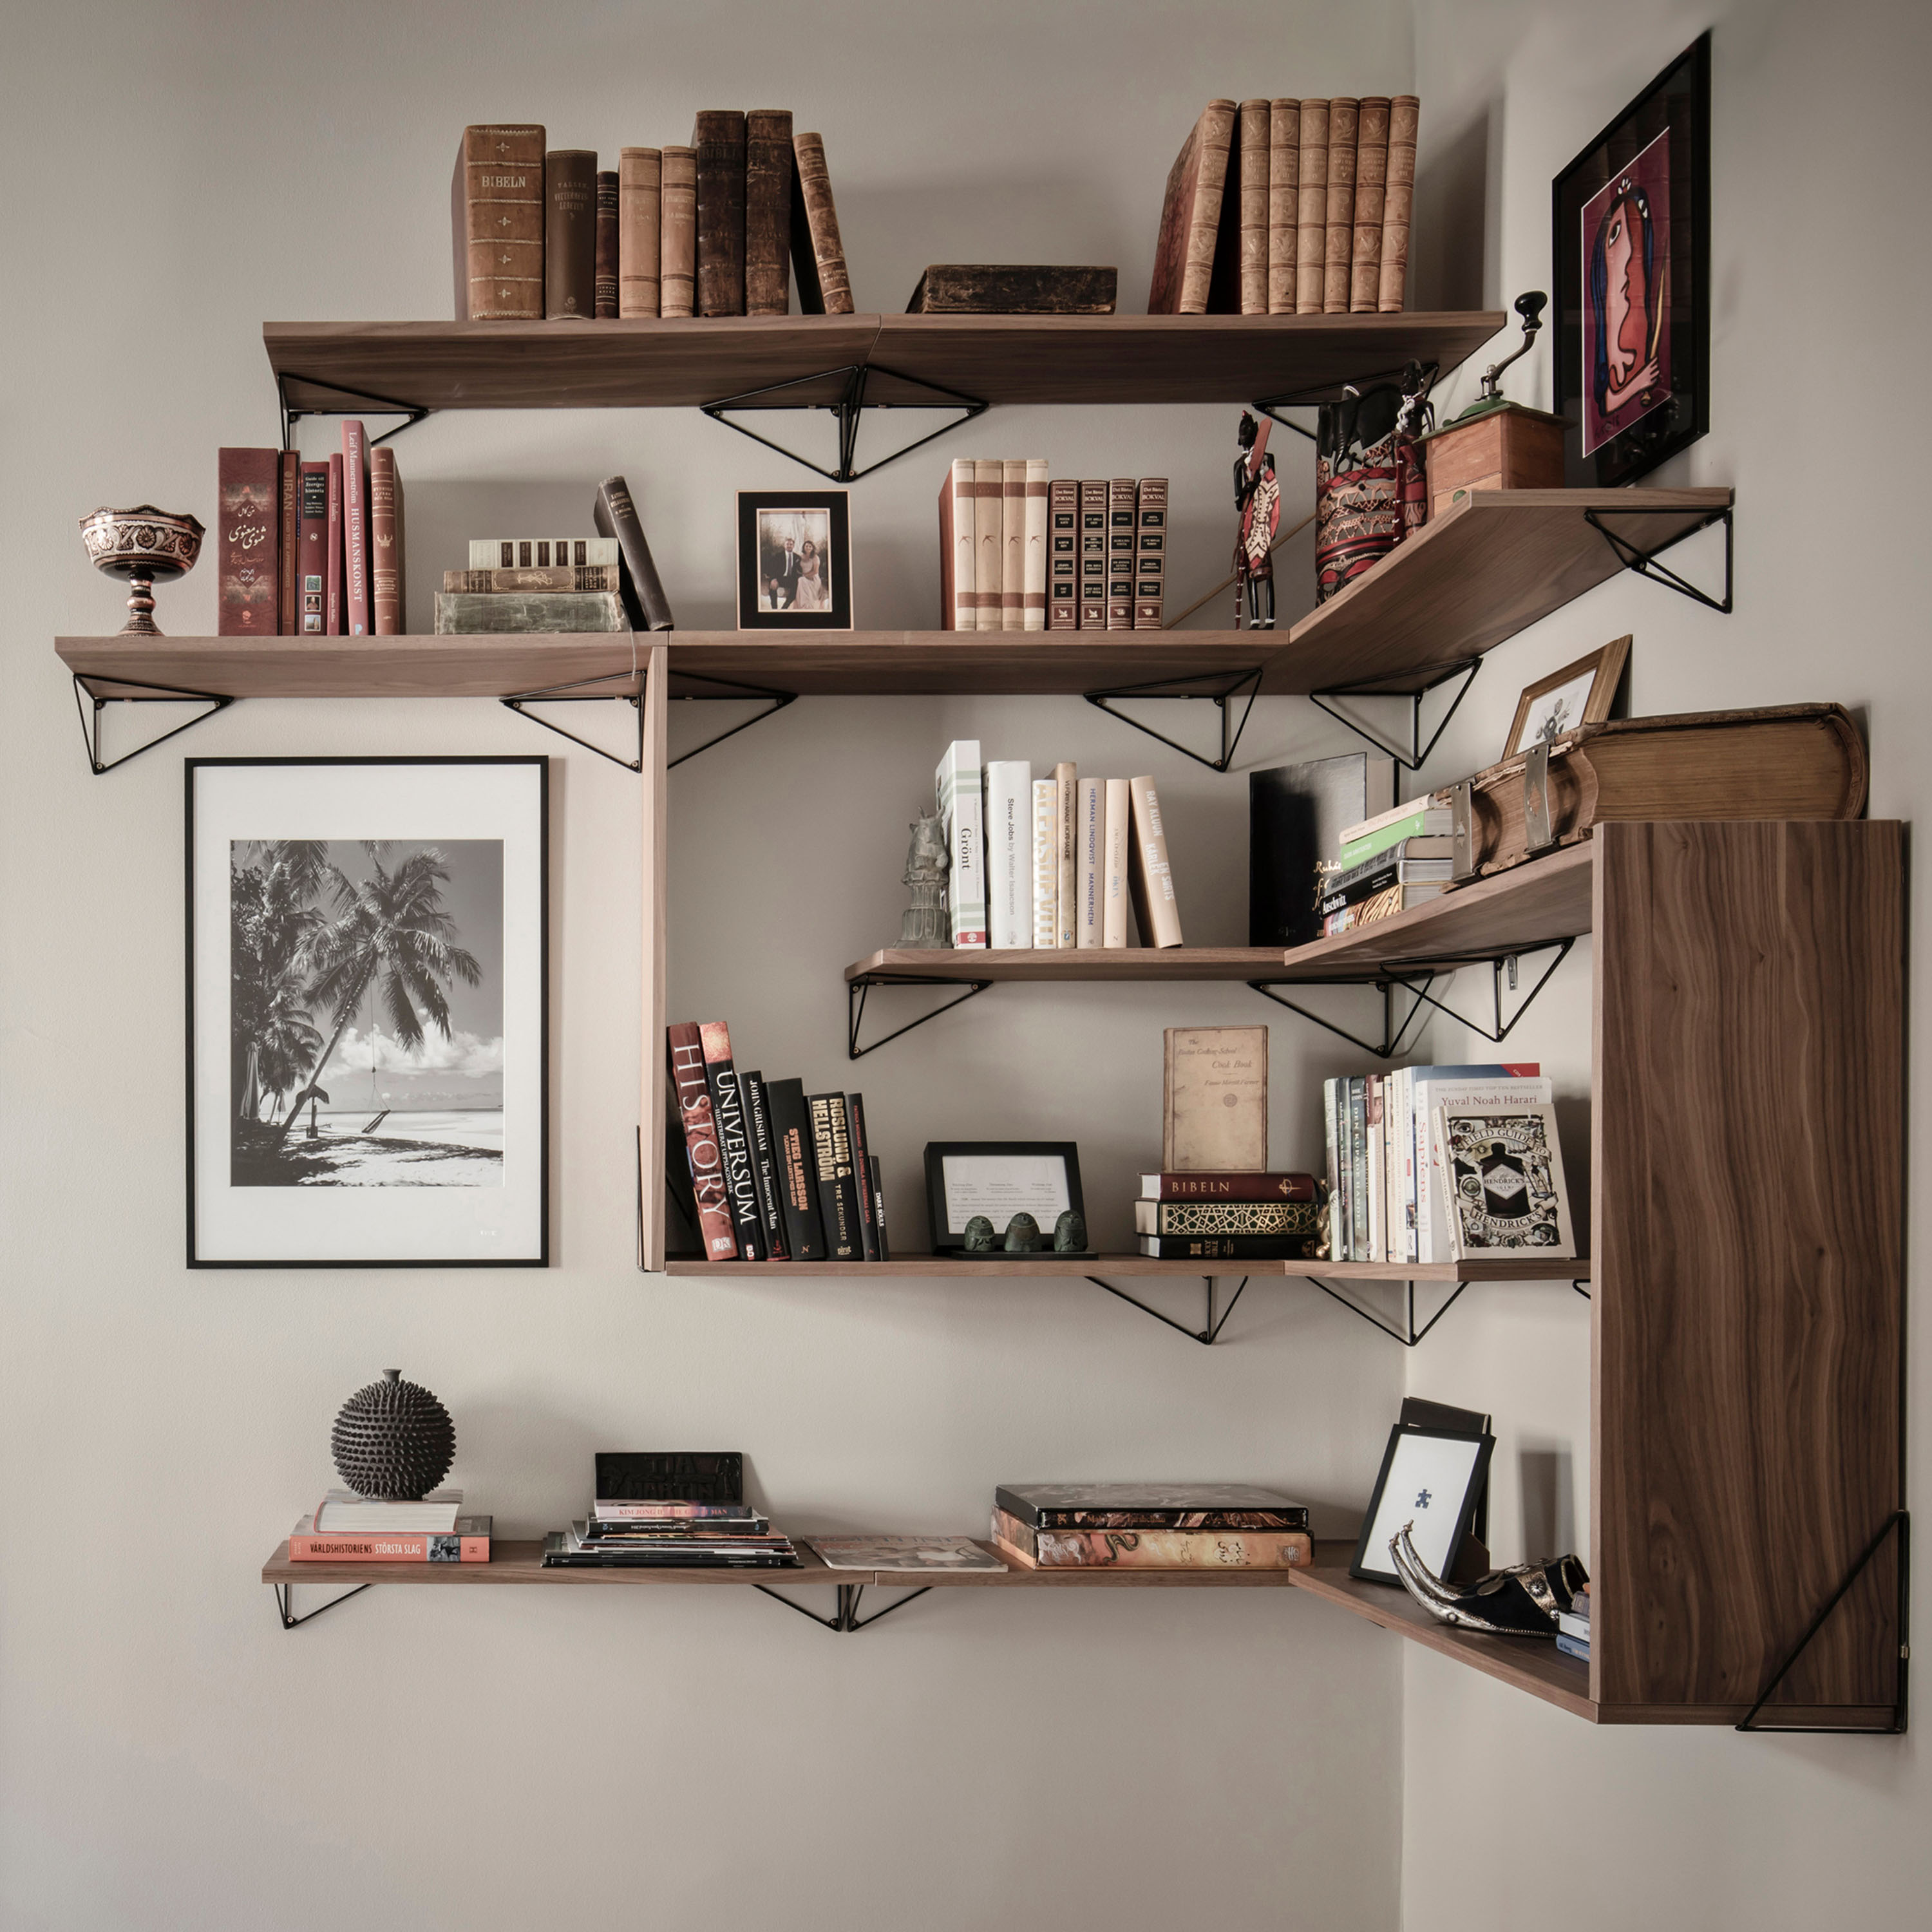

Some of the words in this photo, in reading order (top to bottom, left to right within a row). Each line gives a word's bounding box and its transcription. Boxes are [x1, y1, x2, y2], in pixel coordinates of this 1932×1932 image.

[482, 176, 526, 187] BIBELN
[349, 432, 357, 448] Leif
[349, 450, 359, 504] Mannerström
[284, 479, 293, 510] IRAN
[351, 507, 362, 601] HUSMANSKONST
[1145, 790, 1158, 806] RAY
[1149, 809, 1163, 836] KLUUN
[960, 828, 972, 870] Grönt
[1006, 842, 1014, 851] by
[1145, 843, 1160, 875] KÄRLEK
[1159, 862, 1170, 874] EN
[1161, 876, 1175, 900] SORTS
[1322, 893, 1347, 915] Auschwitz
[1233, 1060, 1253, 1068] Book
[749, 1080, 759, 1104] JOHN
[1441, 1096, 1469, 1106] Yuval
[1473, 1095, 1501, 1104] Noah
[1504, 1095, 1537, 1104] Harari
[674, 1043, 730, 1219] HISTORY
[715, 1107, 726, 1150] ILLUSTRERAT
[753, 1106, 768, 1151] GRISHAM
[788, 1128, 799, 1156] STIEG
[811, 1100, 835, 1181] HELLSTRÖM
[829, 1097, 849, 1160] ROSLUND
[1463, 1129, 1495, 1145] FIELD
[1497, 1128, 1533, 1146] GUIDE
[1535, 1146, 1547, 1155] TO
[716, 1069, 758, 1226] UNIVERSUM
[760, 1159, 769, 1175] The
[837, 1166, 851, 1178] &
[1418, 1122, 1427, 1203] Sapiens
[761, 1175, 774, 1209] Innocent
[792, 1157, 808, 1211] LARSSON
[1172, 1182, 1229, 1193] BIBELN
[768, 1209, 777, 1229] Man
[837, 1201, 847, 1241] SEKUNDER
[1474, 1211, 1542, 1227] HENDRICK'S
[712, 1236, 732, 1251] DK
[310, 1542, 372, 1554] VÄRLDSHISTORIENS
[375, 1541, 403, 1554] STÖRSTA
[404, 1544, 421, 1555] SLAG
